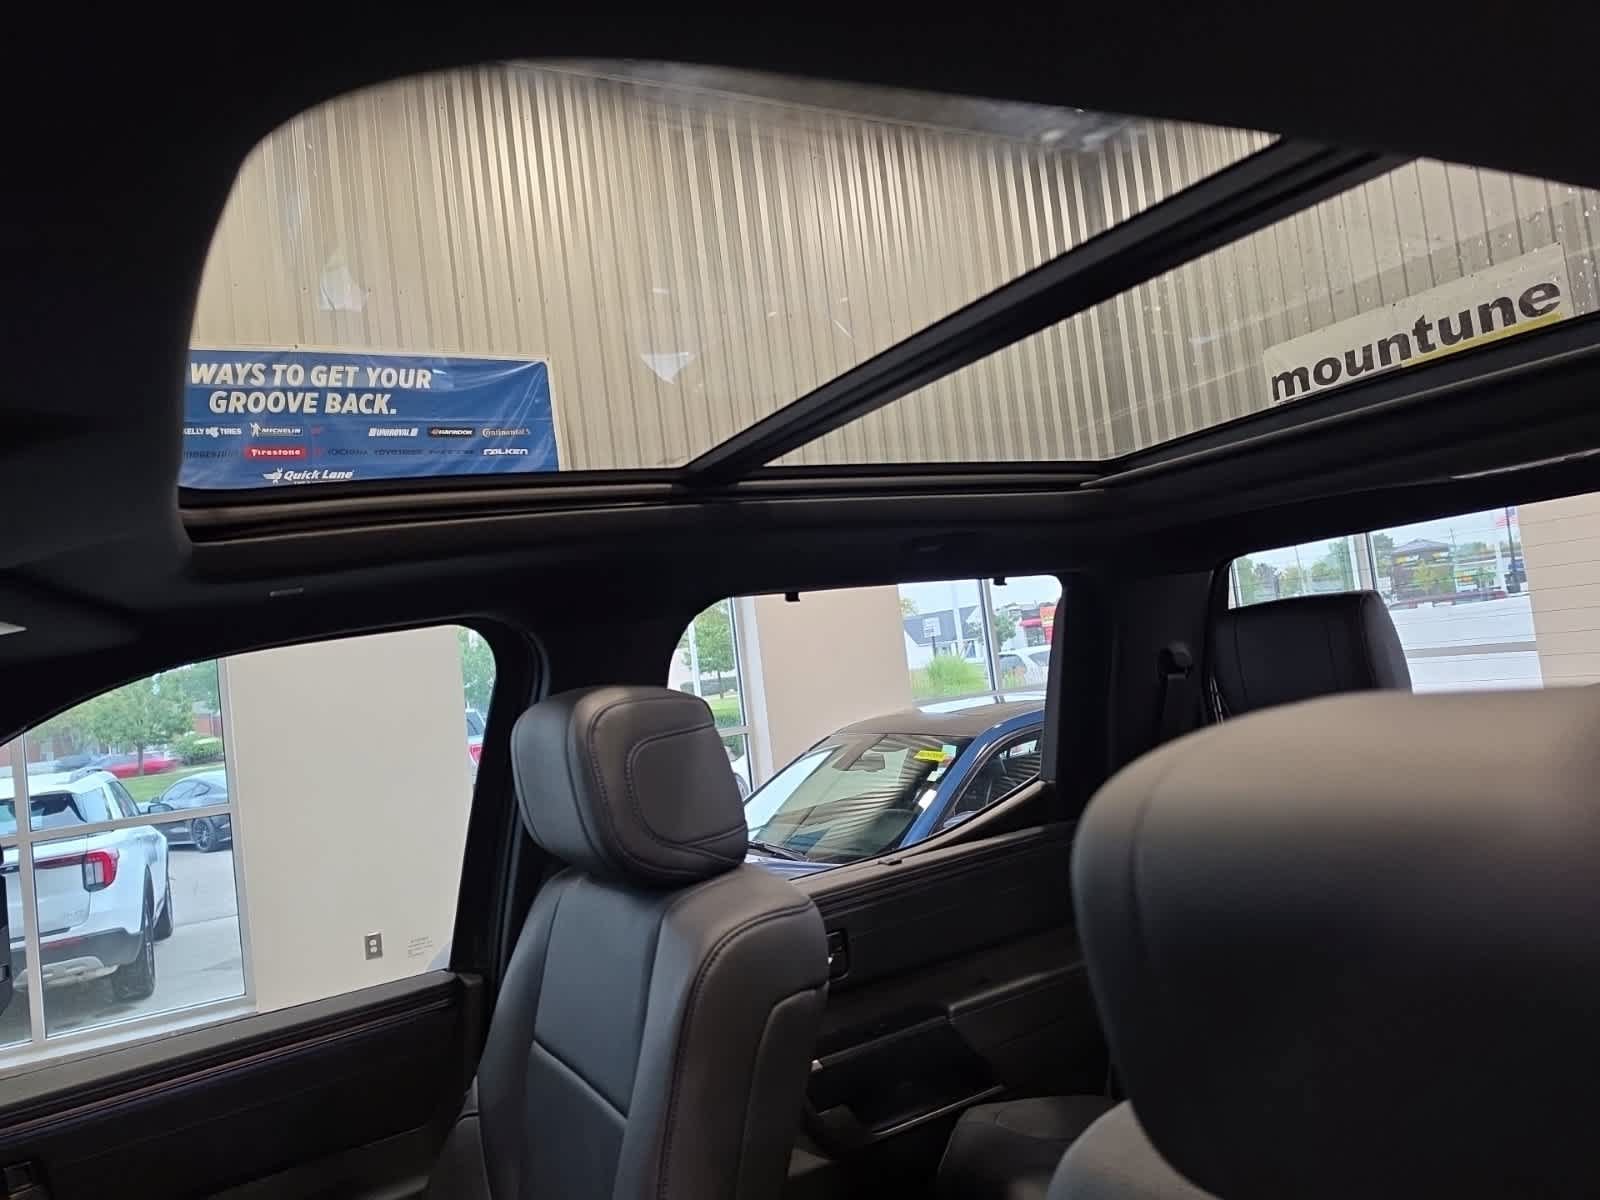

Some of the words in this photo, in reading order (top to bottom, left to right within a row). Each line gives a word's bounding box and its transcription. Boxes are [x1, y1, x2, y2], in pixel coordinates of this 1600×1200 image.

[1271, 282, 1561, 401] mountune
[190, 362, 267, 386] WAYS
[272, 363, 305, 387] TO
[310, 365, 360, 388] GET
[366, 367, 433, 389] YOUR
[209, 390, 319, 414] GROOVE
[324, 393, 397, 415] BACK.
[261, 427, 302, 436] MICHELIN
[250, 448, 301, 458] Firestone
[283, 470, 320, 481] Quick
[321, 469, 353, 480] Lane
